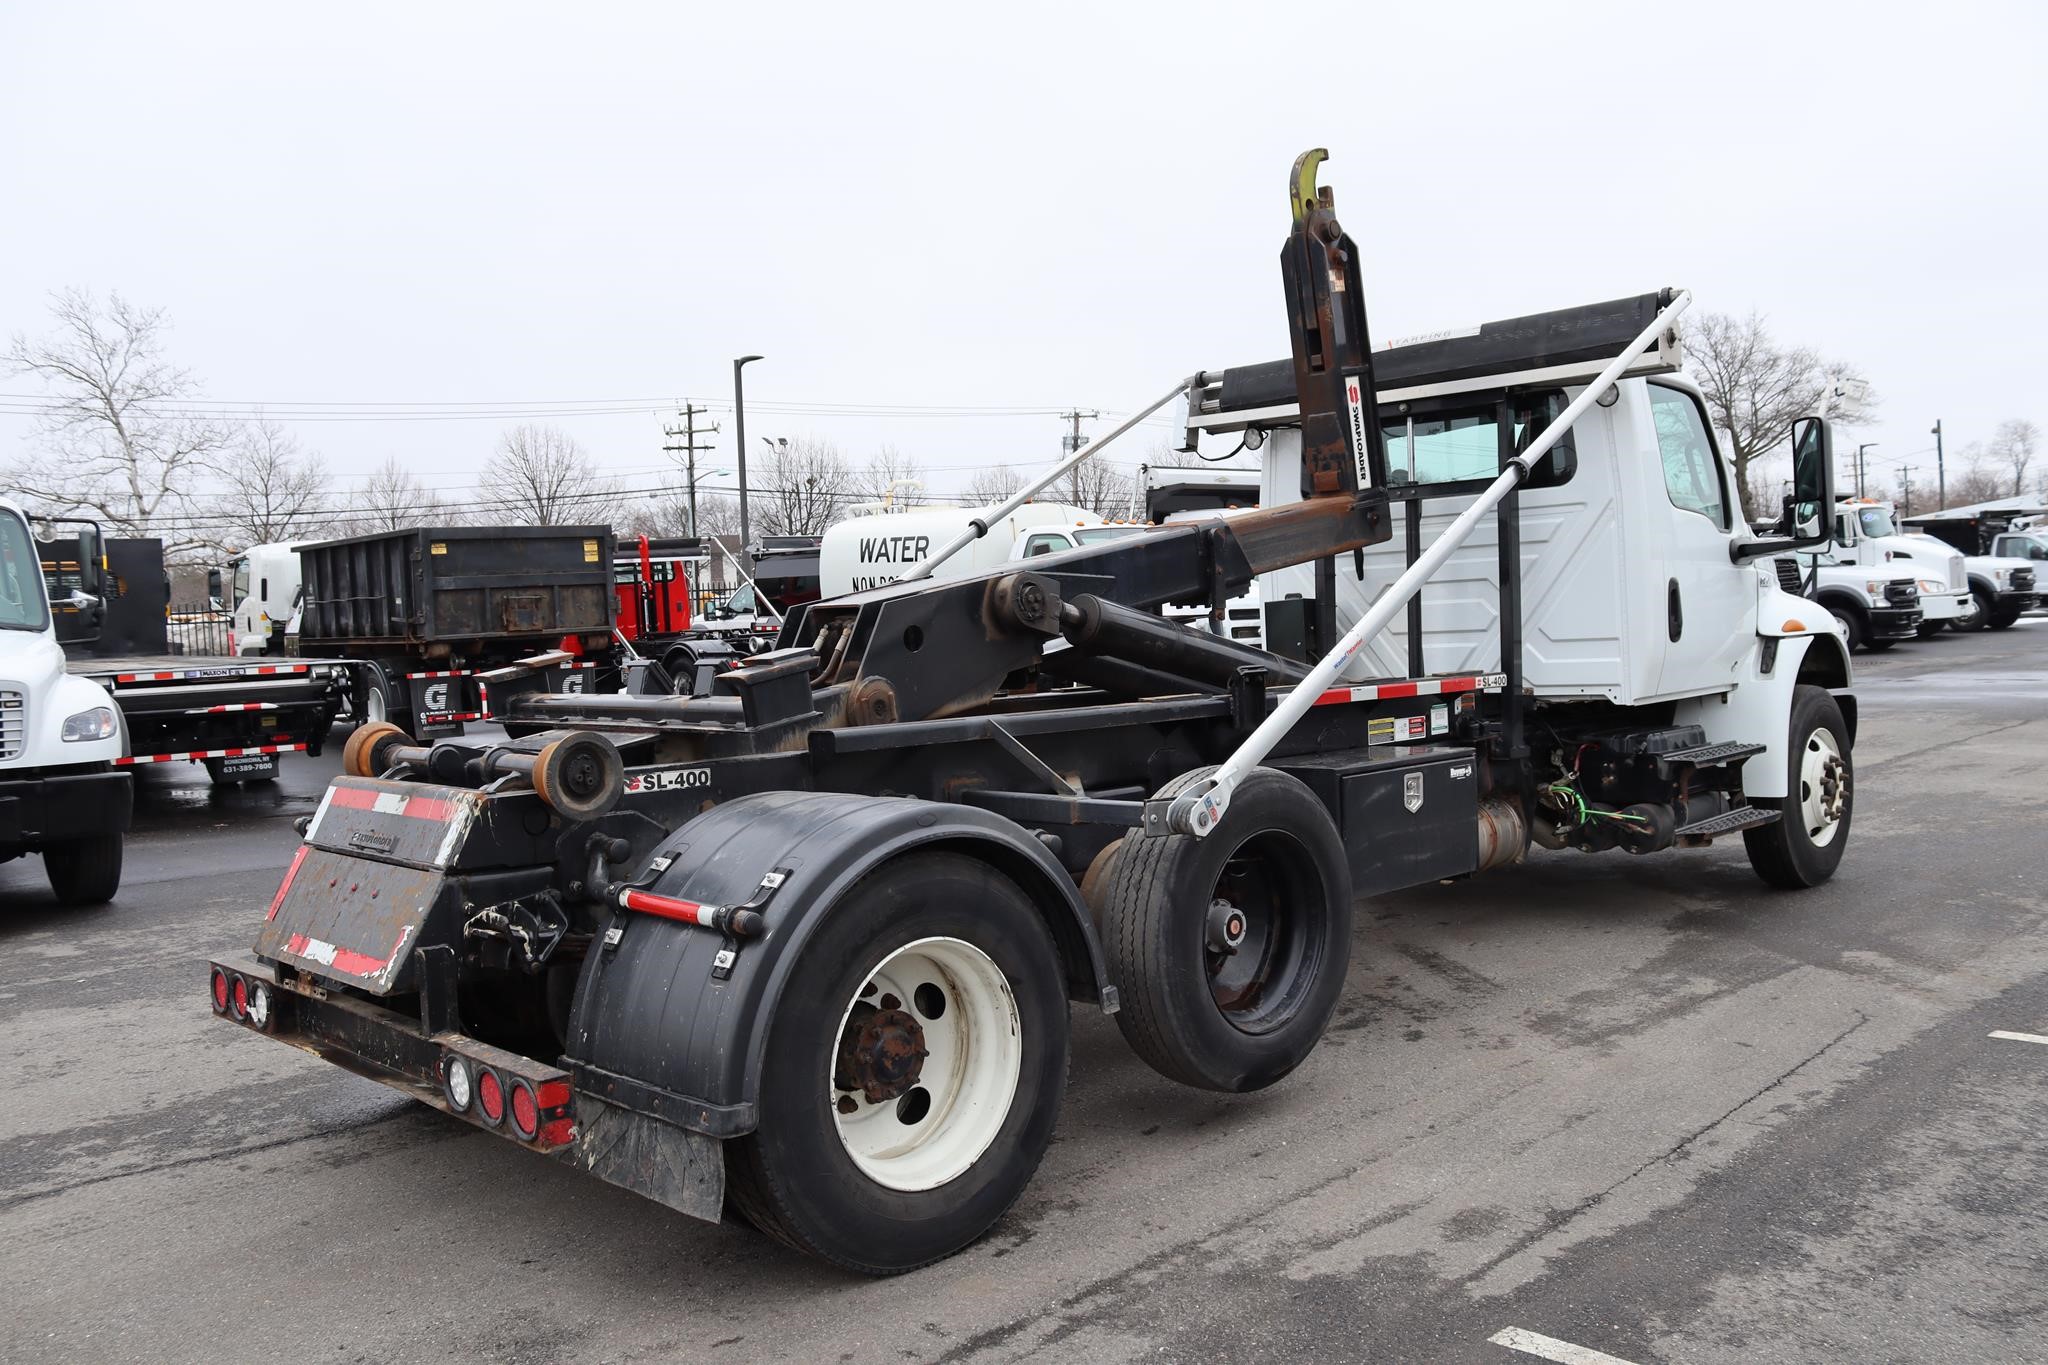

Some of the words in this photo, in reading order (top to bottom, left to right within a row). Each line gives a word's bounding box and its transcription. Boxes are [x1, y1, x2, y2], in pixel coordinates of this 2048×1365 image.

[1353, 406, 1367, 480] SWAPLOADER
[860, 536, 929, 563] WATER
[852, 576, 876, 592] NON
[1483, 675, 1507, 687] SL-400
[424, 683, 448, 710] G
[223, 763, 272, 773] 631-389-7800
[643, 771, 709, 790] SL-400
